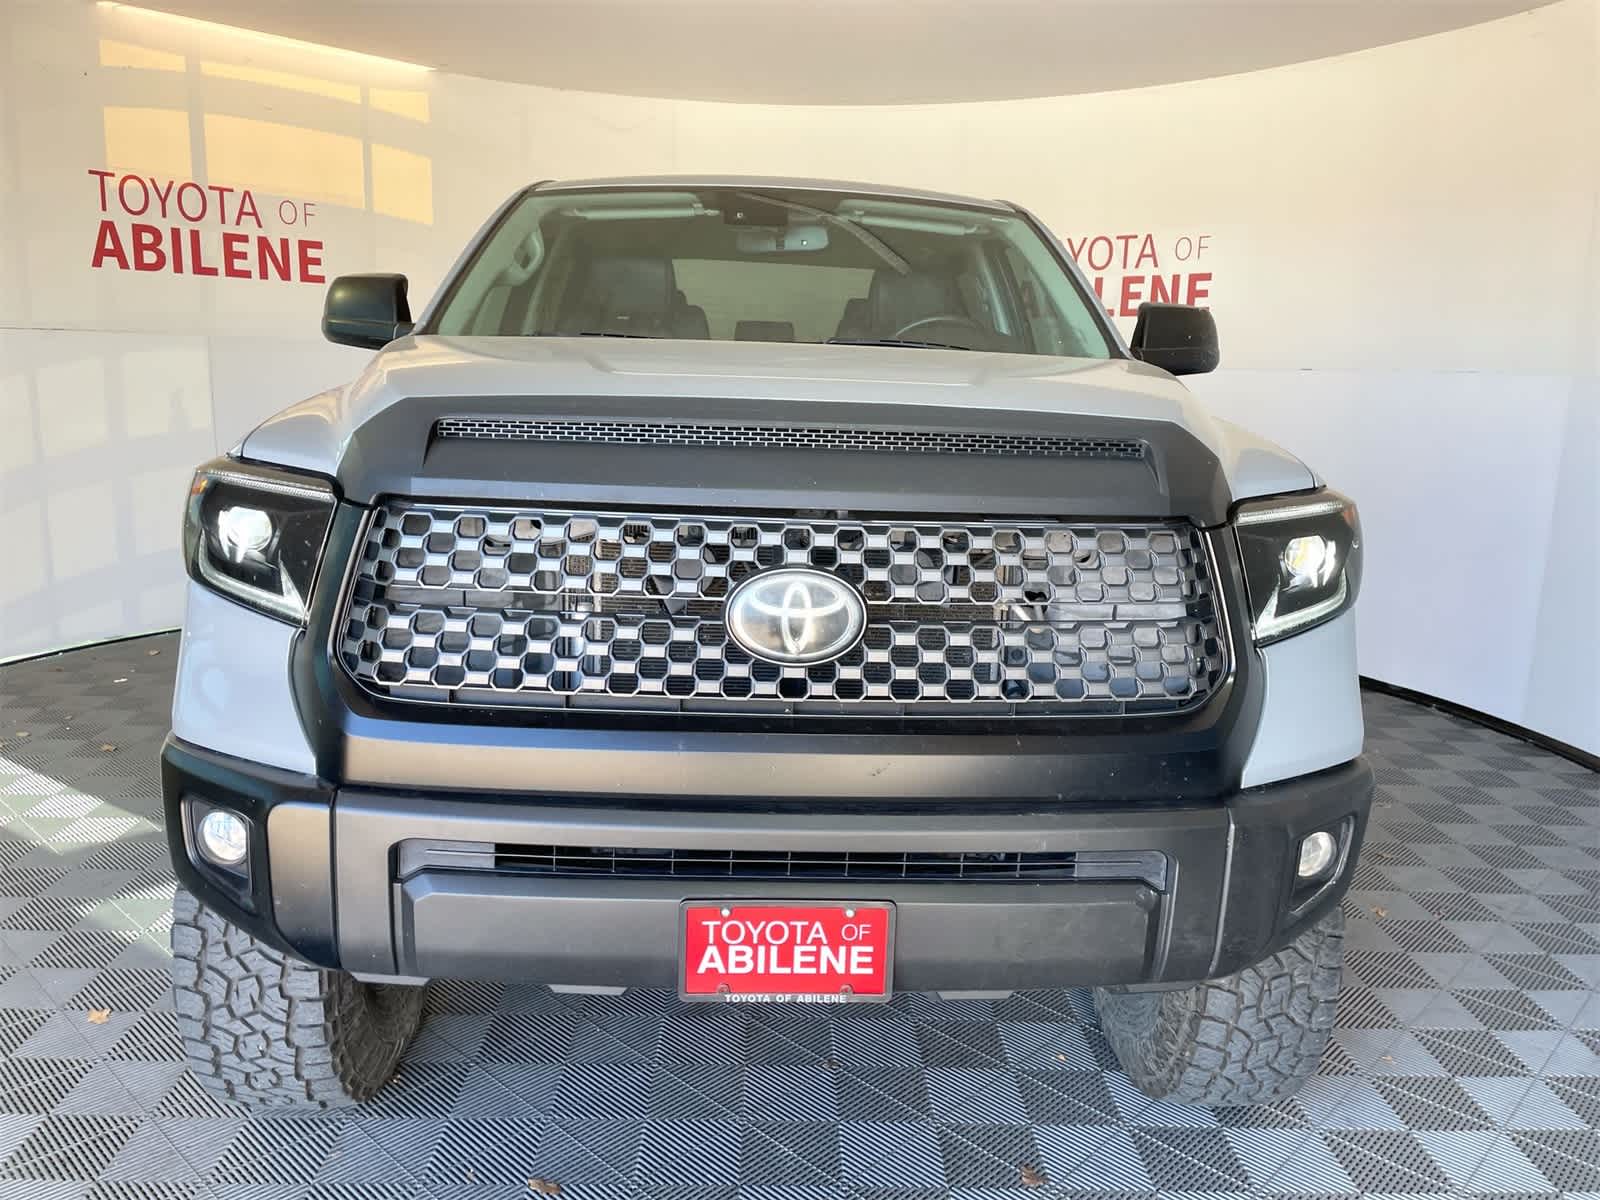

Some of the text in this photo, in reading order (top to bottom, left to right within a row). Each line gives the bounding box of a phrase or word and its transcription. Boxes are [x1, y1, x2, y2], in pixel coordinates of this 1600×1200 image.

[88, 169, 316, 228] TOYOTA OF
[92, 220, 326, 284] ABILENE
[1067, 234, 1212, 271] YOTA OF
[1094, 272, 1213, 317] LENE
[701, 920, 872, 945] TOYOTA OF
[696, 945, 874, 974] ABILENE
[724, 994, 848, 1003] TOYOTA OF ABILENE
